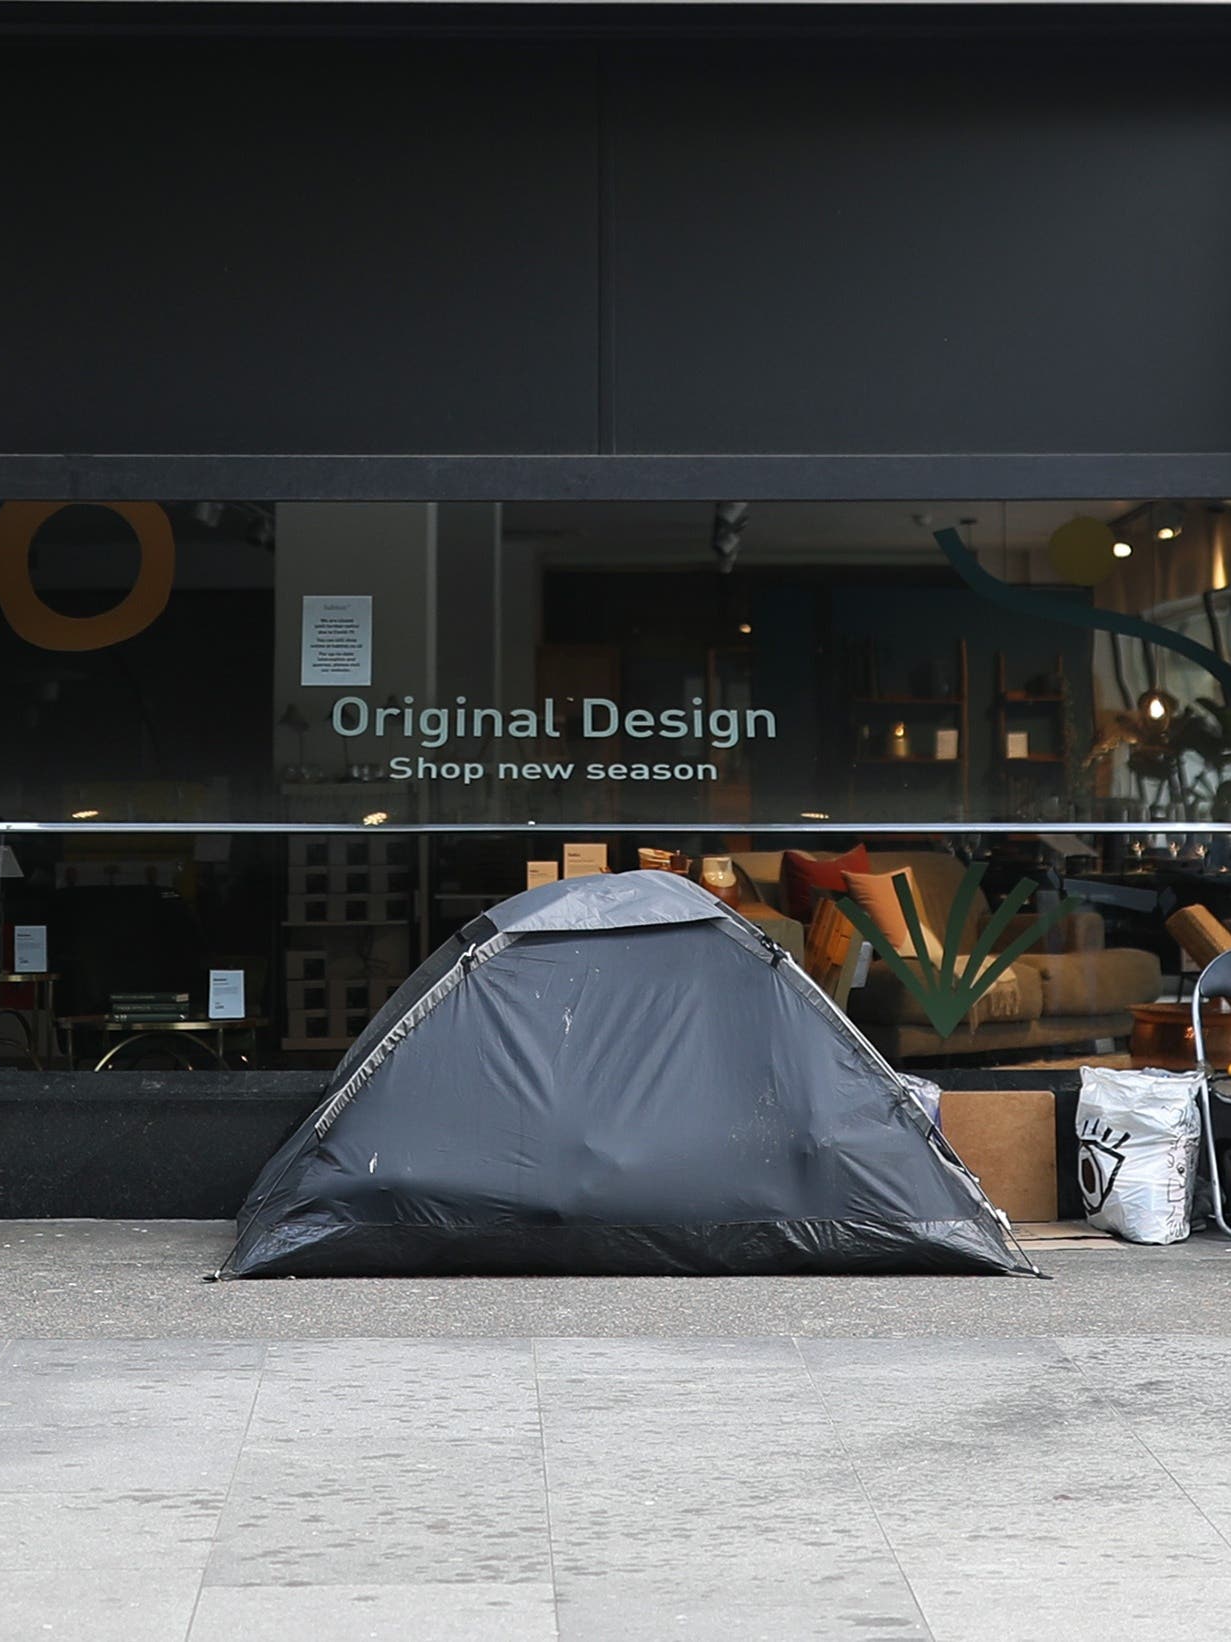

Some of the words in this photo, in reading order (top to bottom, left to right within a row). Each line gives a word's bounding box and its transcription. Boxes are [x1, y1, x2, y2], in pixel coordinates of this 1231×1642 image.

[333, 696, 560, 748] Original
[583, 697, 776, 748] Design
[389, 756, 484, 785] Shop
[498, 763, 575, 780] new
[586, 763, 717, 780] season
